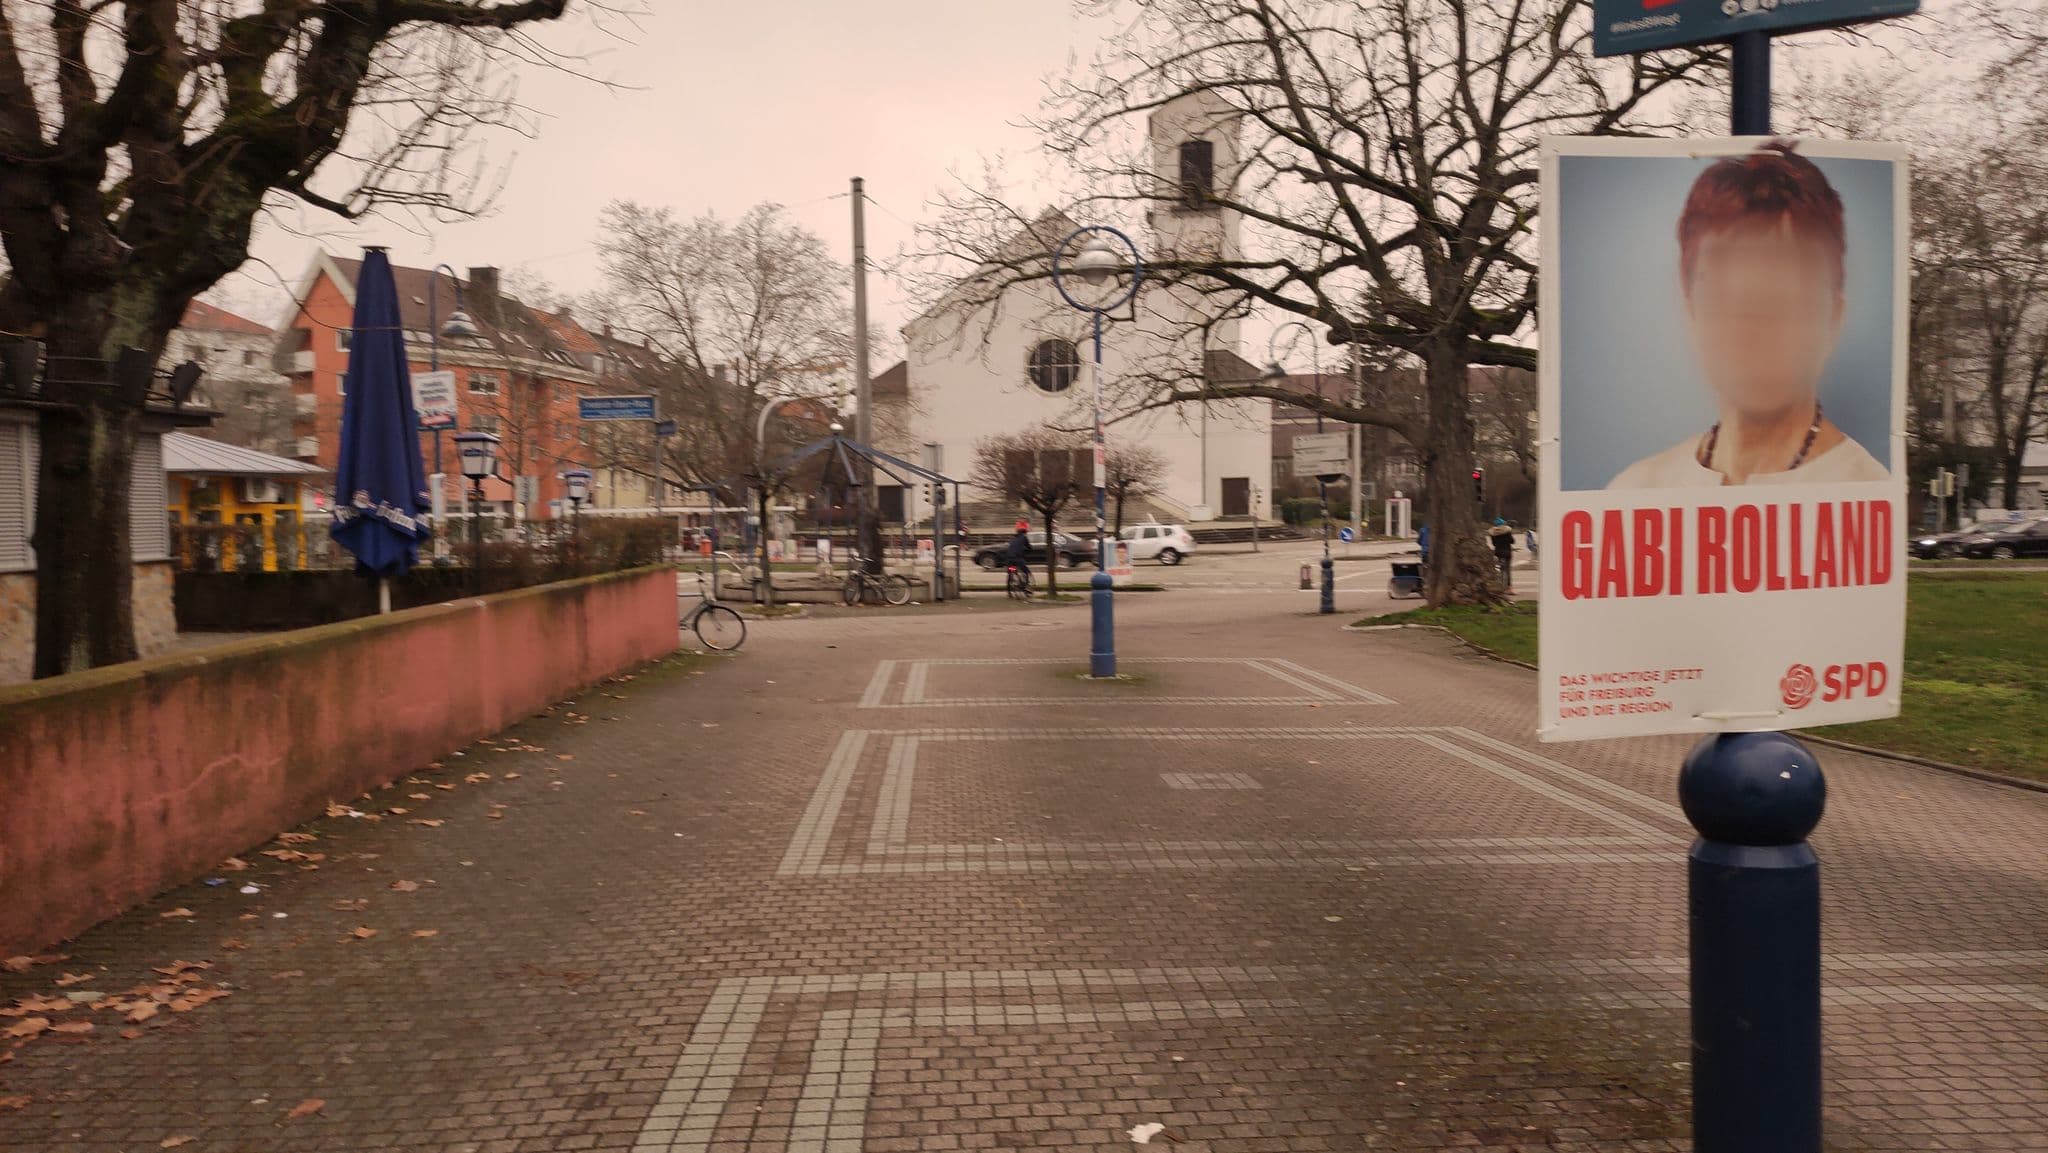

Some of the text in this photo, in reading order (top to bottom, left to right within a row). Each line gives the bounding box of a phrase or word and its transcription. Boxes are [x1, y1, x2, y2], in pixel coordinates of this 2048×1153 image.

[1561, 500, 1892, 601] GABI ROLLAND
[1560, 668, 1703, 687] DAS WICHTIGE JETZT
[1822, 661, 1888, 703] SPD
[1559, 687, 1655, 702] FÜR FREIBURG
[1559, 701, 1673, 719] UND DIE REGION
